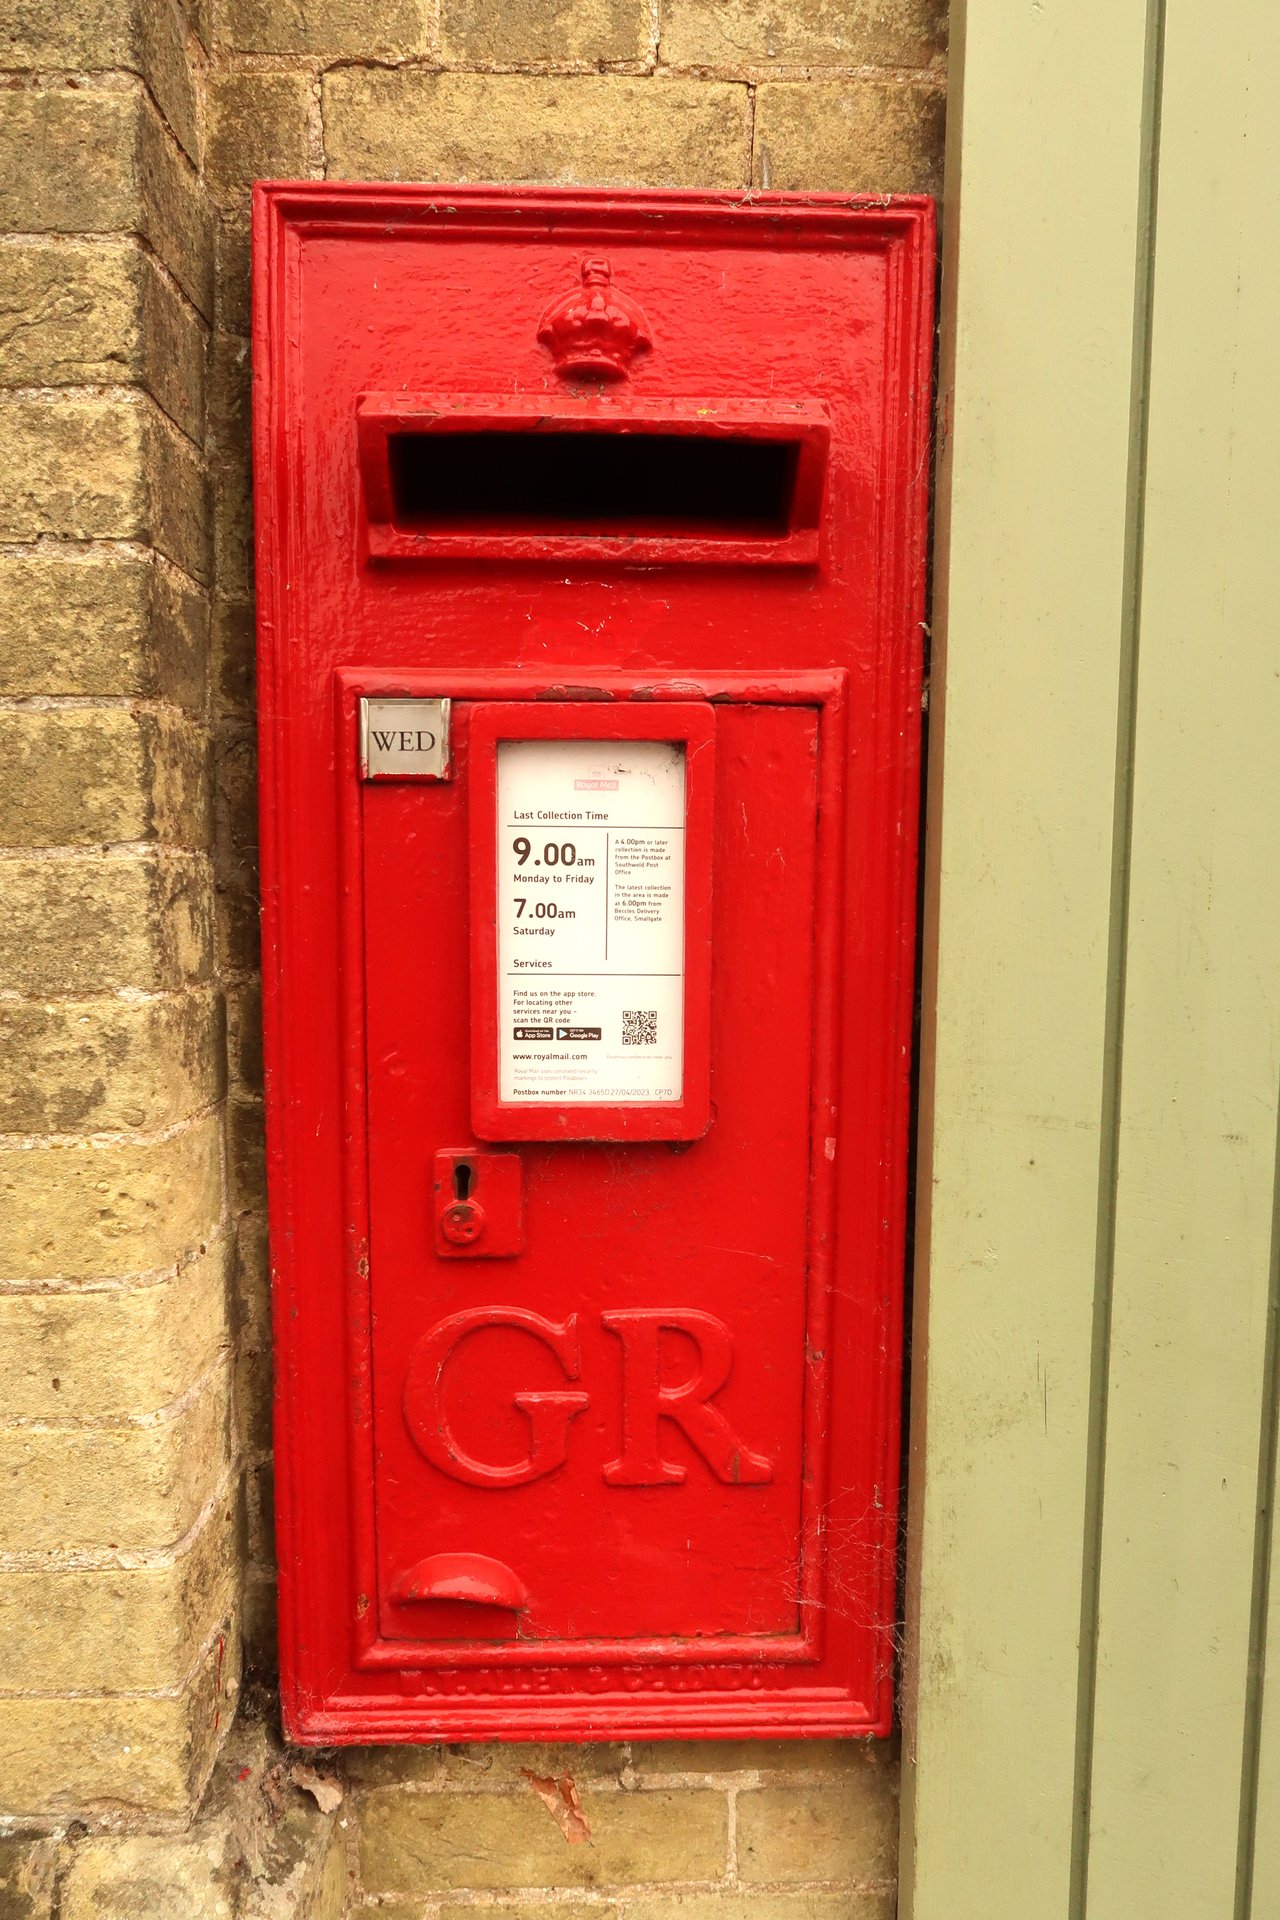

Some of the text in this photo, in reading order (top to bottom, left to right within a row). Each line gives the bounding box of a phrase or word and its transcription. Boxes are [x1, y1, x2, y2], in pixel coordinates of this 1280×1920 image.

[371, 731, 435, 752] WED
[514, 811, 608, 820] Last Collection Time
[512, 837, 595, 866] 9.00am
[514, 874, 550, 884] Monday
[566, 875, 594, 884] Friday
[514, 898, 576, 918] 7.00am
[513, 927, 555, 936] Saturday
[513, 959, 552, 968] Services
[513, 1053, 588, 1061] www.royalmail.com
